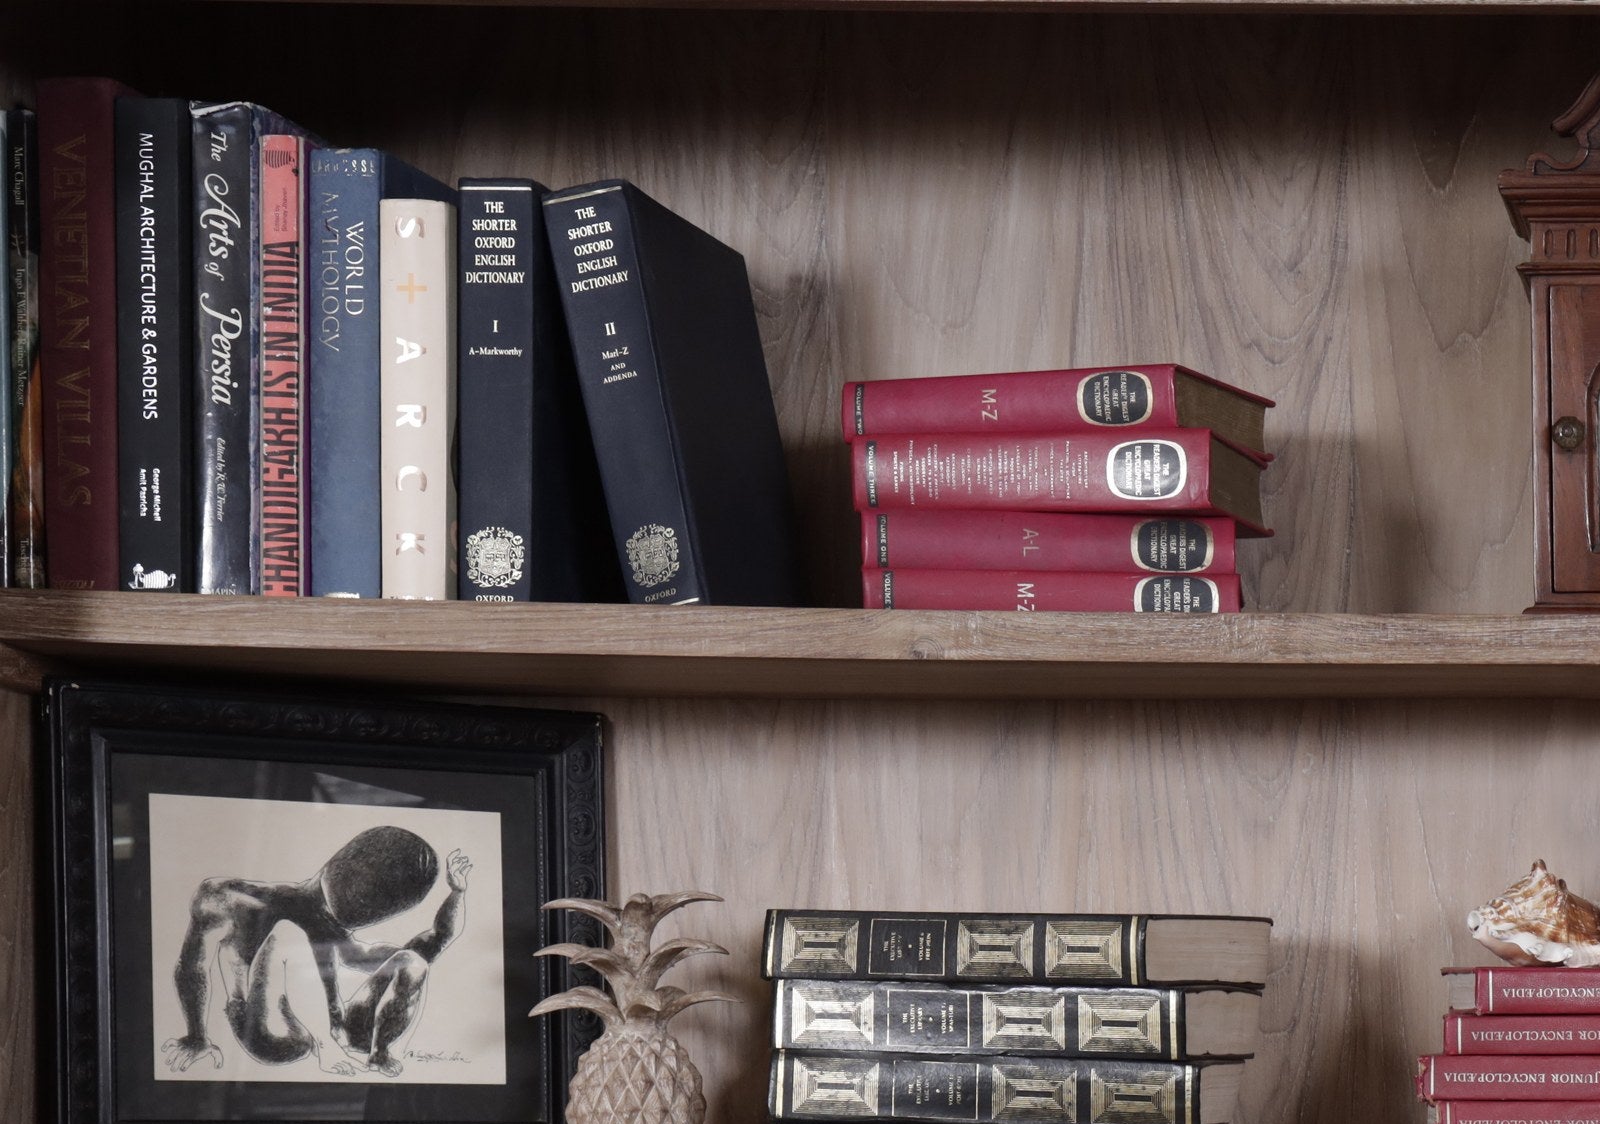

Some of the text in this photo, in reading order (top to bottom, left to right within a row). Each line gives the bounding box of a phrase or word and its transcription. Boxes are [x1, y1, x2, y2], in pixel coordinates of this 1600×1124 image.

[13, 147, 25, 206] Marc Chagall
[484, 201, 505, 213] THE
[575, 206, 597, 220] THE
[472, 219, 517, 231] SHORTER
[567, 221, 613, 240] SHORTER
[53, 134, 90, 350] VENETIAN
[474, 236, 515, 249] OXFORD
[573, 239, 614, 256] OXFORD
[200, 131, 243, 406] The Arts of Persia
[345, 221, 364, 316] WORLD
[474, 254, 516, 266] ENGLISH
[577, 255, 618, 274] ENGLISH
[139, 132, 158, 420] MUGHAL ARCHITECTURE & GARDENS
[319, 192, 340, 352] MYTHOLOGY
[465, 271, 525, 284] DICTIONARY
[263, 241, 299, 323] INDIA
[571, 270, 629, 293] DICTIONARY
[492, 319, 499, 333] I
[604, 322, 617, 336] II
[263, 331, 299, 362] IN
[468, 346, 523, 357] A-Markworthy
[601, 346, 630, 360] Marl-Z
[610, 362, 626, 371] AND
[263, 370, 299, 399] IS
[603, 370, 638, 384] ADDENDA
[855, 387, 863, 415] VOLUME
[982, 389, 998, 421] M-Z
[867, 445, 875, 477] VOLUME
[215, 437, 226, 522] Edited by Ferrier
[139, 468, 147, 517] Amit Pasricha
[152, 467, 162, 522] George Michell
[1022, 528, 1039, 557] A-L
[879, 545, 887, 563] ONE
[475, 594, 514, 603] OXFORD
[645, 587, 677, 603] OXFORD
[1471, 1030, 1573, 1041] ENCYCLOPÆDIA
[1444, 1072, 1545, 1083] ENCYCLOPÆDIA
[1551, 1071, 1600, 1084] JUNIOR
